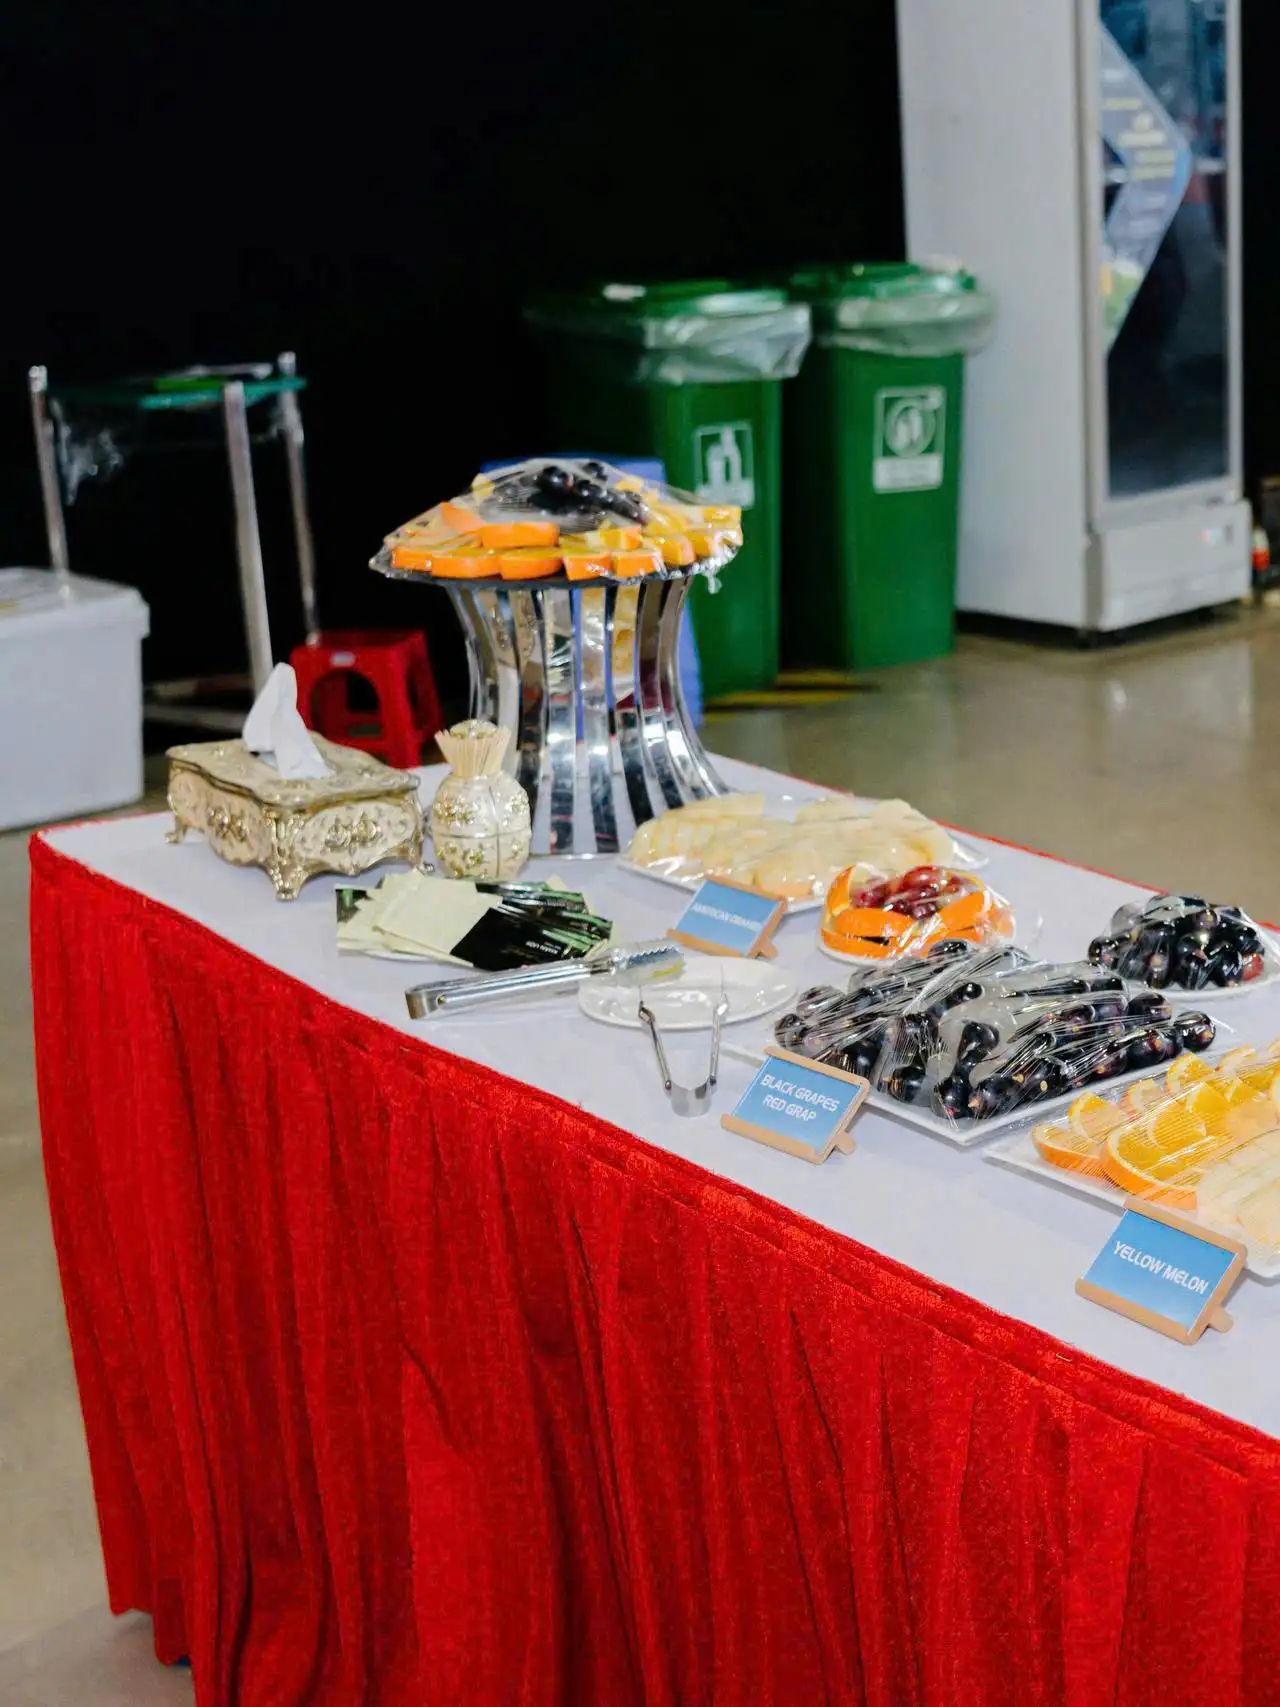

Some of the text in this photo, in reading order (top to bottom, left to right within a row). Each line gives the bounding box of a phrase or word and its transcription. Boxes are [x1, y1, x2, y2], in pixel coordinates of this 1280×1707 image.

[760, 1075, 840, 1112] BLACK GRAPES
[763, 1095, 817, 1121] RED GRAP
[1113, 1240, 1209, 1294] YELLOW MELON
